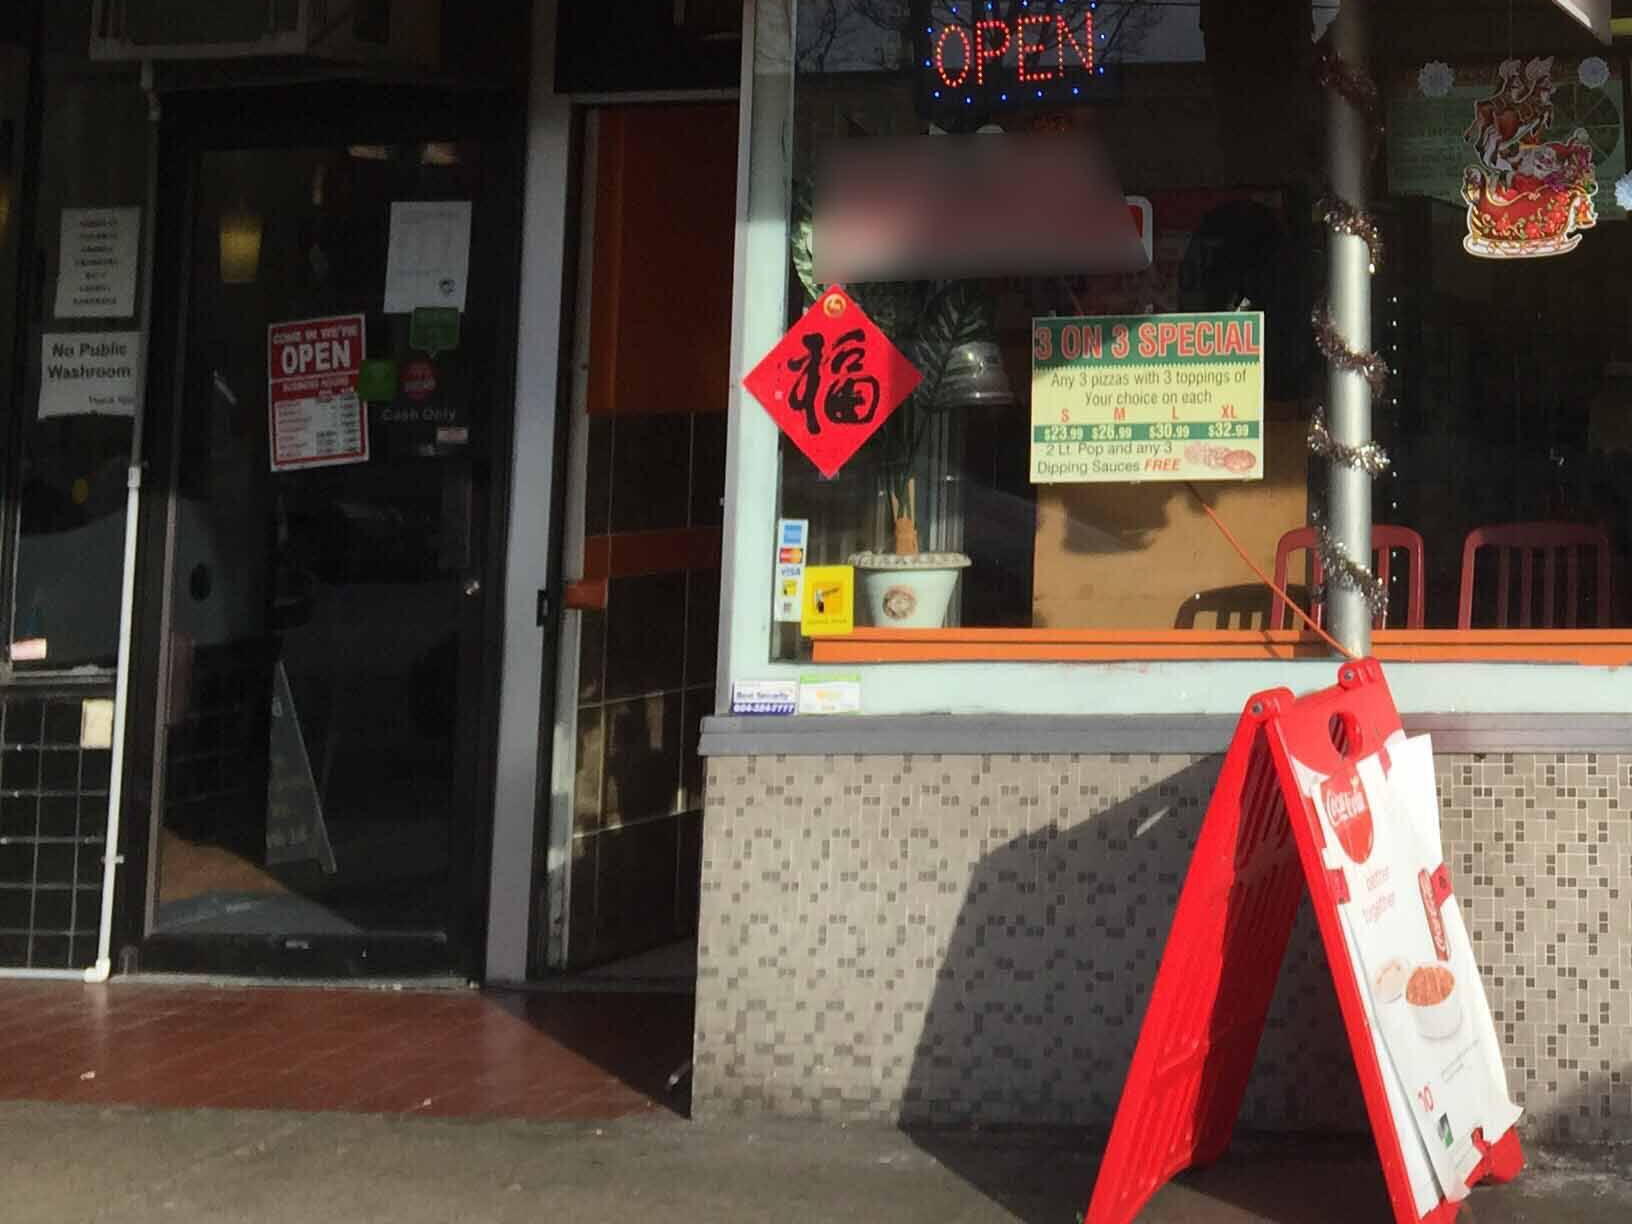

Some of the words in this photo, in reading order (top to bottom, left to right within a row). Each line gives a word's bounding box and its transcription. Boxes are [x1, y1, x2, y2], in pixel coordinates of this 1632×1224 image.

[936, 11, 1095, 87] OPEN
[51, 344, 74, 357] No
[80, 342, 127, 357] Public
[1035, 326, 1052, 360] 3
[1061, 324, 1102, 360] ON
[1111, 324, 1129, 358] 3
[1138, 320, 1260, 358] SPECIAL
[281, 339, 351, 375] OPEN
[48, 364, 130, 380] Washroom
[787, 327, 880, 434] 福
[1051, 372, 1073, 389] Any
[1080, 373, 1088, 387] 3
[1092, 372, 1129, 390] pizzas
[1135, 370, 1161, 385] with
[1163, 370, 1172, 383] 3
[1176, 370, 1231, 388] toppings
[1234, 369, 1247, 383] of
[1084, 392, 1112, 406] Your
[1117, 391, 1158, 405] choice
[1162, 393, 1177, 404] on
[1182, 390, 1212, 403] each
[1060, 408, 1069, 423] S
[1113, 407, 1126, 421] M
[1172, 406, 1180, 420] L
[1221, 404, 1238, 419] XL
[1078, 443, 1104, 457] Pop
[1110, 442, 1132, 455] and
[1137, 443, 1160, 457] any
[1163, 441, 1172, 453] 3
[1037, 460, 1088, 476] Dipping
[1092, 459, 1140, 473] Sauces
[1144, 458, 1182, 472] FREE
